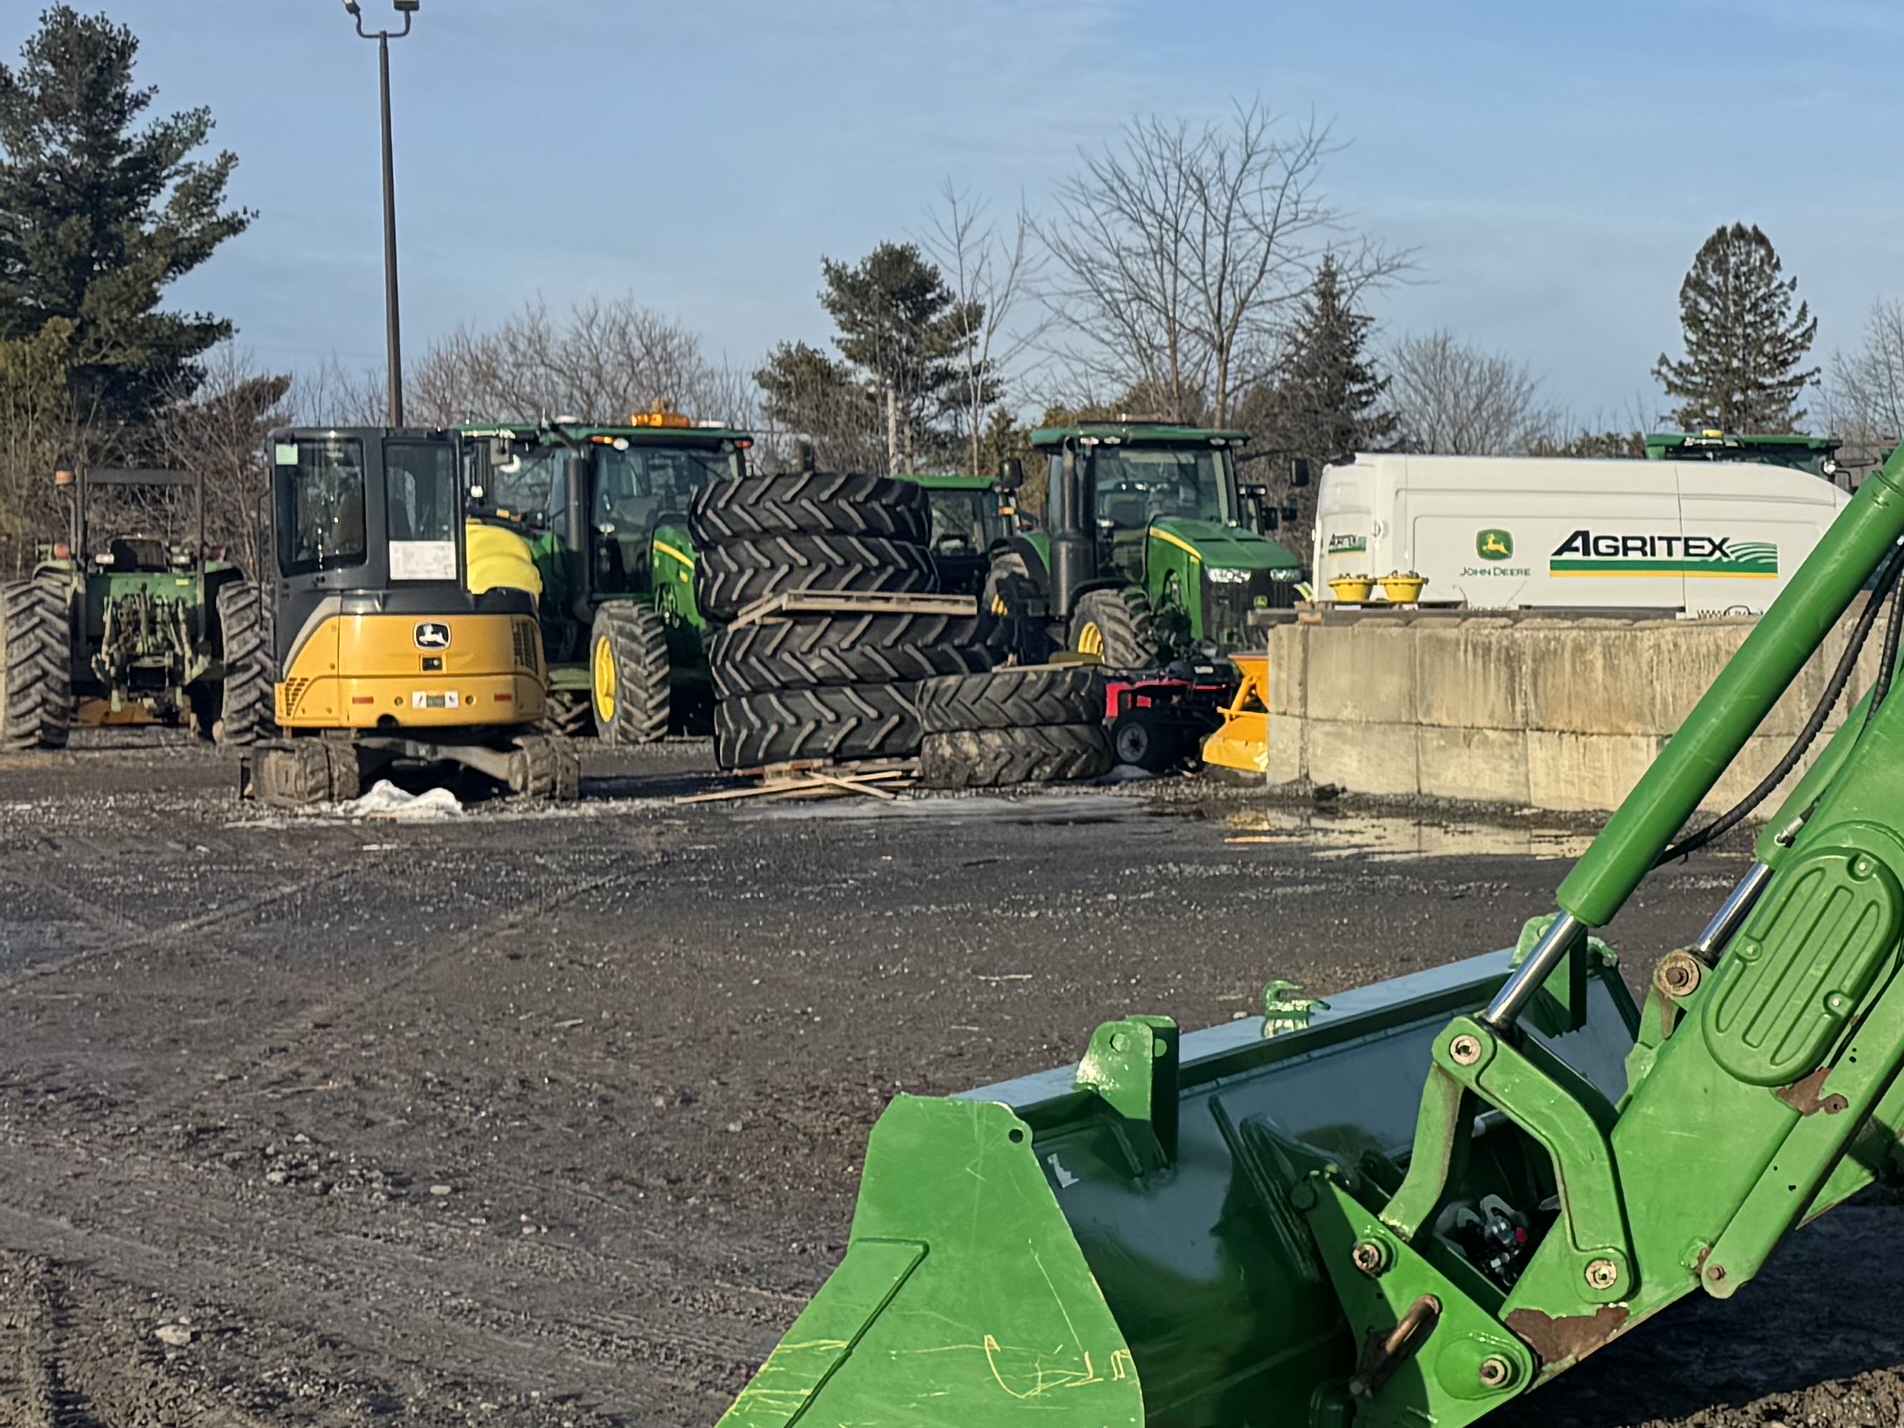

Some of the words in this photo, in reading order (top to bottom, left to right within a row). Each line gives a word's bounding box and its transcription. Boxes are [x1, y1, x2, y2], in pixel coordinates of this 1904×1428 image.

[1552, 530, 1731, 558] AGRITEX
[1460, 567, 1492, 577] JOHN
[1494, 567, 1531, 576] DEERE
